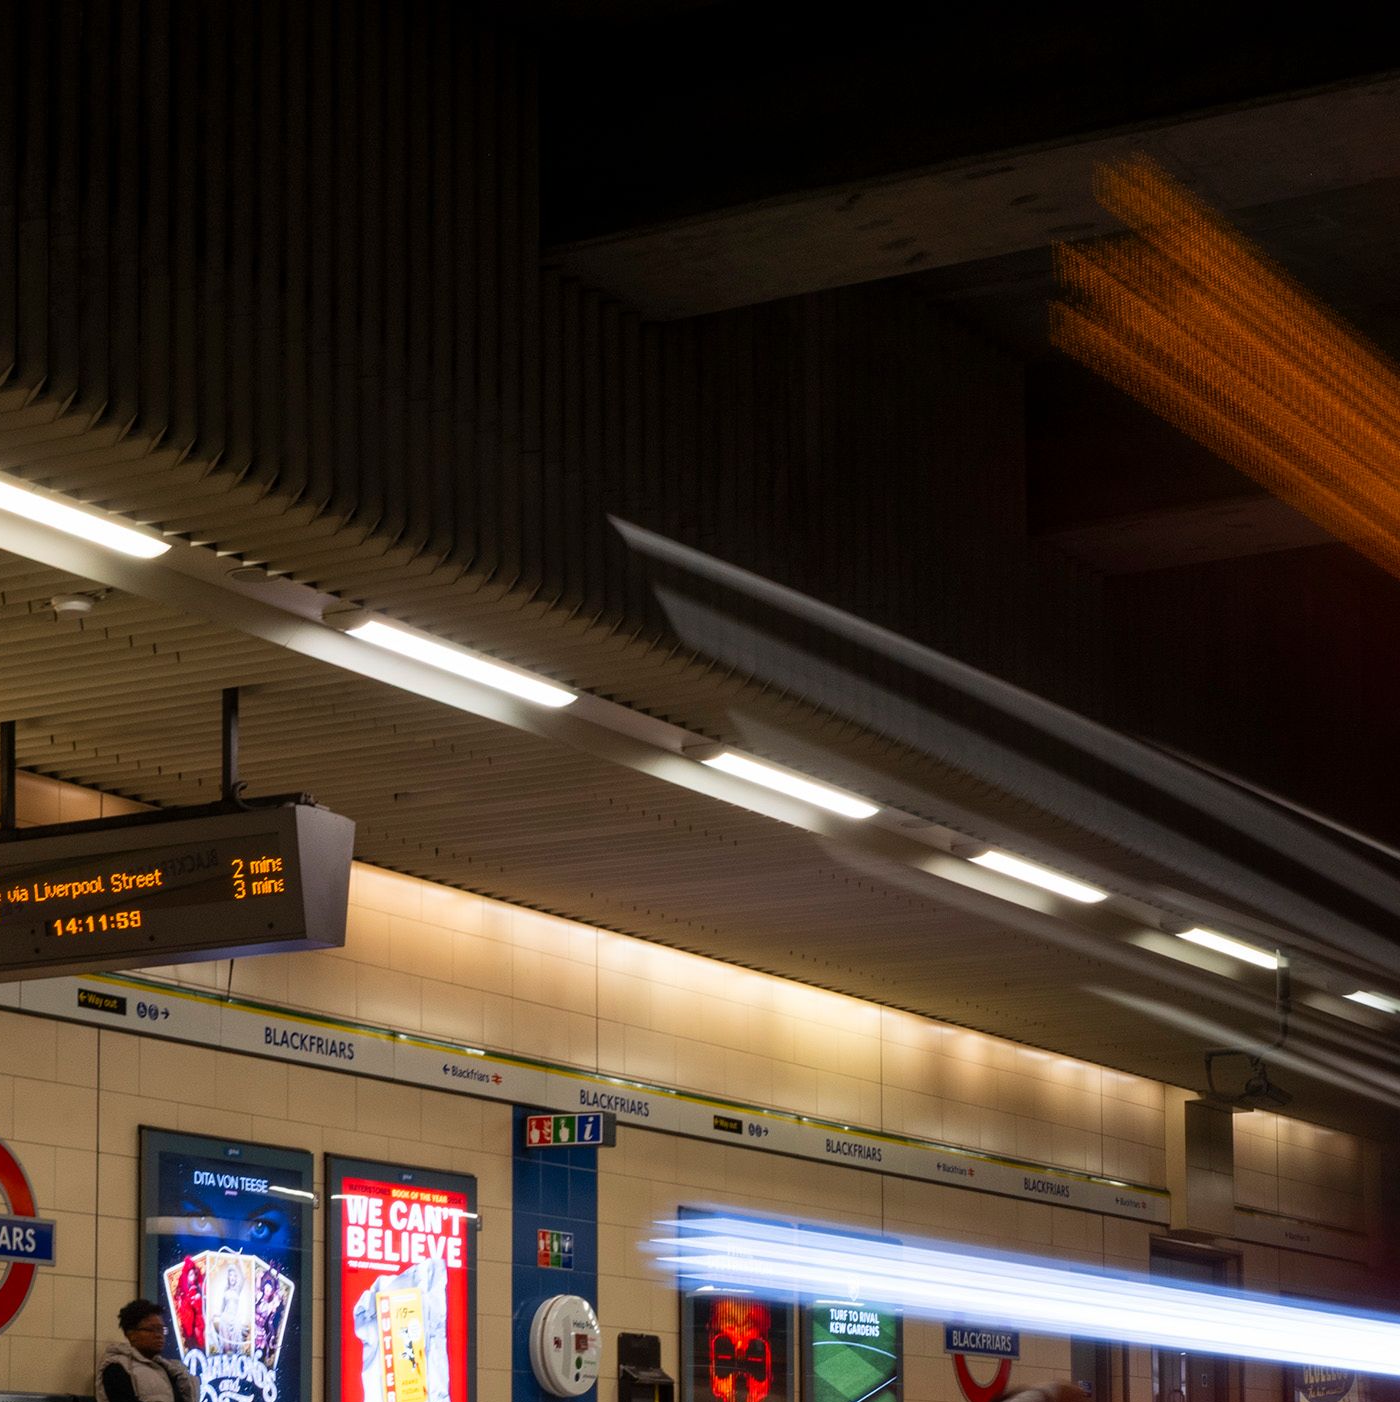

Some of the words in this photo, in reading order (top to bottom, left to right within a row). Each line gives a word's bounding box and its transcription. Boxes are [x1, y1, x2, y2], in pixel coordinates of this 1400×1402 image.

[231, 858, 245, 878] 2
[250, 856, 283, 874] mins
[7, 886, 29, 902] via
[34, 876, 105, 902] Liverpool
[110, 869, 163, 892] Street
[233, 880, 246, 899] 3
[252, 877, 284, 895] mins
[53, 910, 142, 936] 14:11:59
[264, 1026, 355, 1060] BLACKFRIARS
[451, 1066, 490, 1084] Blackfriars
[580, 1089, 650, 1117] BLACKFRIARS
[826, 1138, 882, 1162] BLACKFRIARS
[194, 1171, 216, 1186] DITA
[216, 1174, 239, 1189] VON
[239, 1177, 268, 1193] TEESE
[1023, 1177, 1070, 1198] BLACKFRIARS
[391, 1189, 410, 1198] BOOK
[419, 1192, 431, 1201] THE
[432, 1194, 448, 1203] YEAR
[345, 1196, 383, 1228] WE
[389, 1200, 464, 1236] CAN'T
[346, 1225, 462, 1269] BELIEVE
[829, 1308, 848, 1321] TURF
[848, 1310, 859, 1322] TO
[859, 1311, 880, 1324] RIVAL
[829, 1321, 846, 1334] KEW
[847, 1323, 880, 1337] GARDENS
[953, 1330, 1012, 1352] BLACKFRIARS
